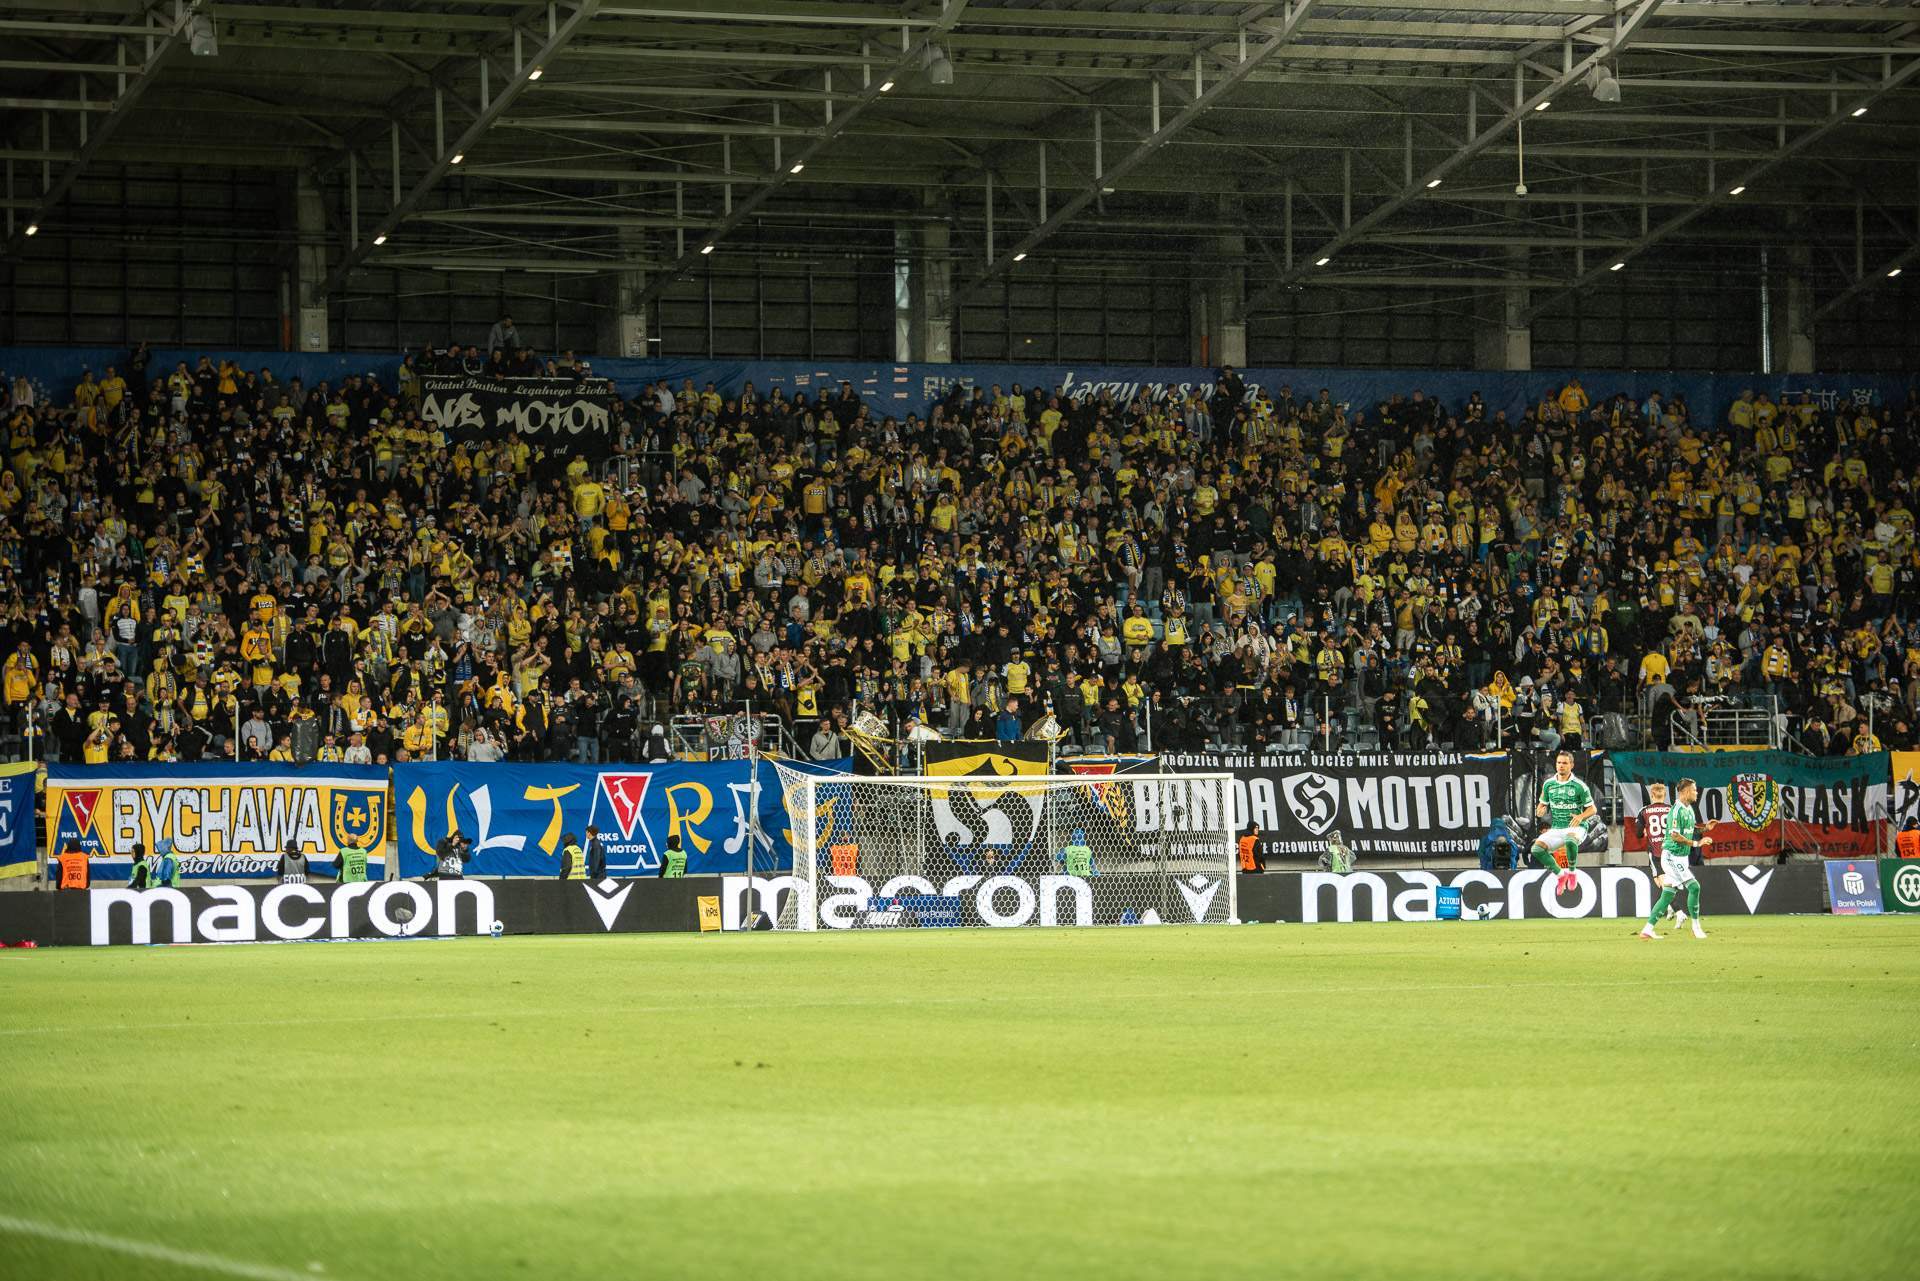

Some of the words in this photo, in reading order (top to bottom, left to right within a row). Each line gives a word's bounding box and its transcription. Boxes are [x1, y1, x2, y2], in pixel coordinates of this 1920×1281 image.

[425, 380, 465, 391] Ostatni
[465, 378, 509, 394] Bastion
[1147, 381, 1191, 404] ns
[421, 393, 486, 430] AVE
[496, 400, 609, 435] MOTOR
[1224, 755, 1256, 768] MNIE
[1359, 755, 1389, 766] MNIE
[1394, 752, 1463, 766] WYCHOWAŁ
[1135, 777, 1279, 833] BANDA
[1346, 774, 1492, 831] MOTOR
[112, 787, 326, 853] BYCHAWA
[61, 831, 78, 839] RKS
[597, 833, 619, 841] RKS
[1361, 839, 1371, 851] W
[1374, 839, 1428, 853] KRYMINALE
[1430, 838, 1481, 852] GRYPSOW
[606, 845, 647, 854] MOTOR
[146, 854, 211, 875] Msto
[351, 866, 365, 875] 022
[723, 874, 1093, 930] macron
[1302, 866, 1652, 922] macron
[91, 880, 494, 945] macron
